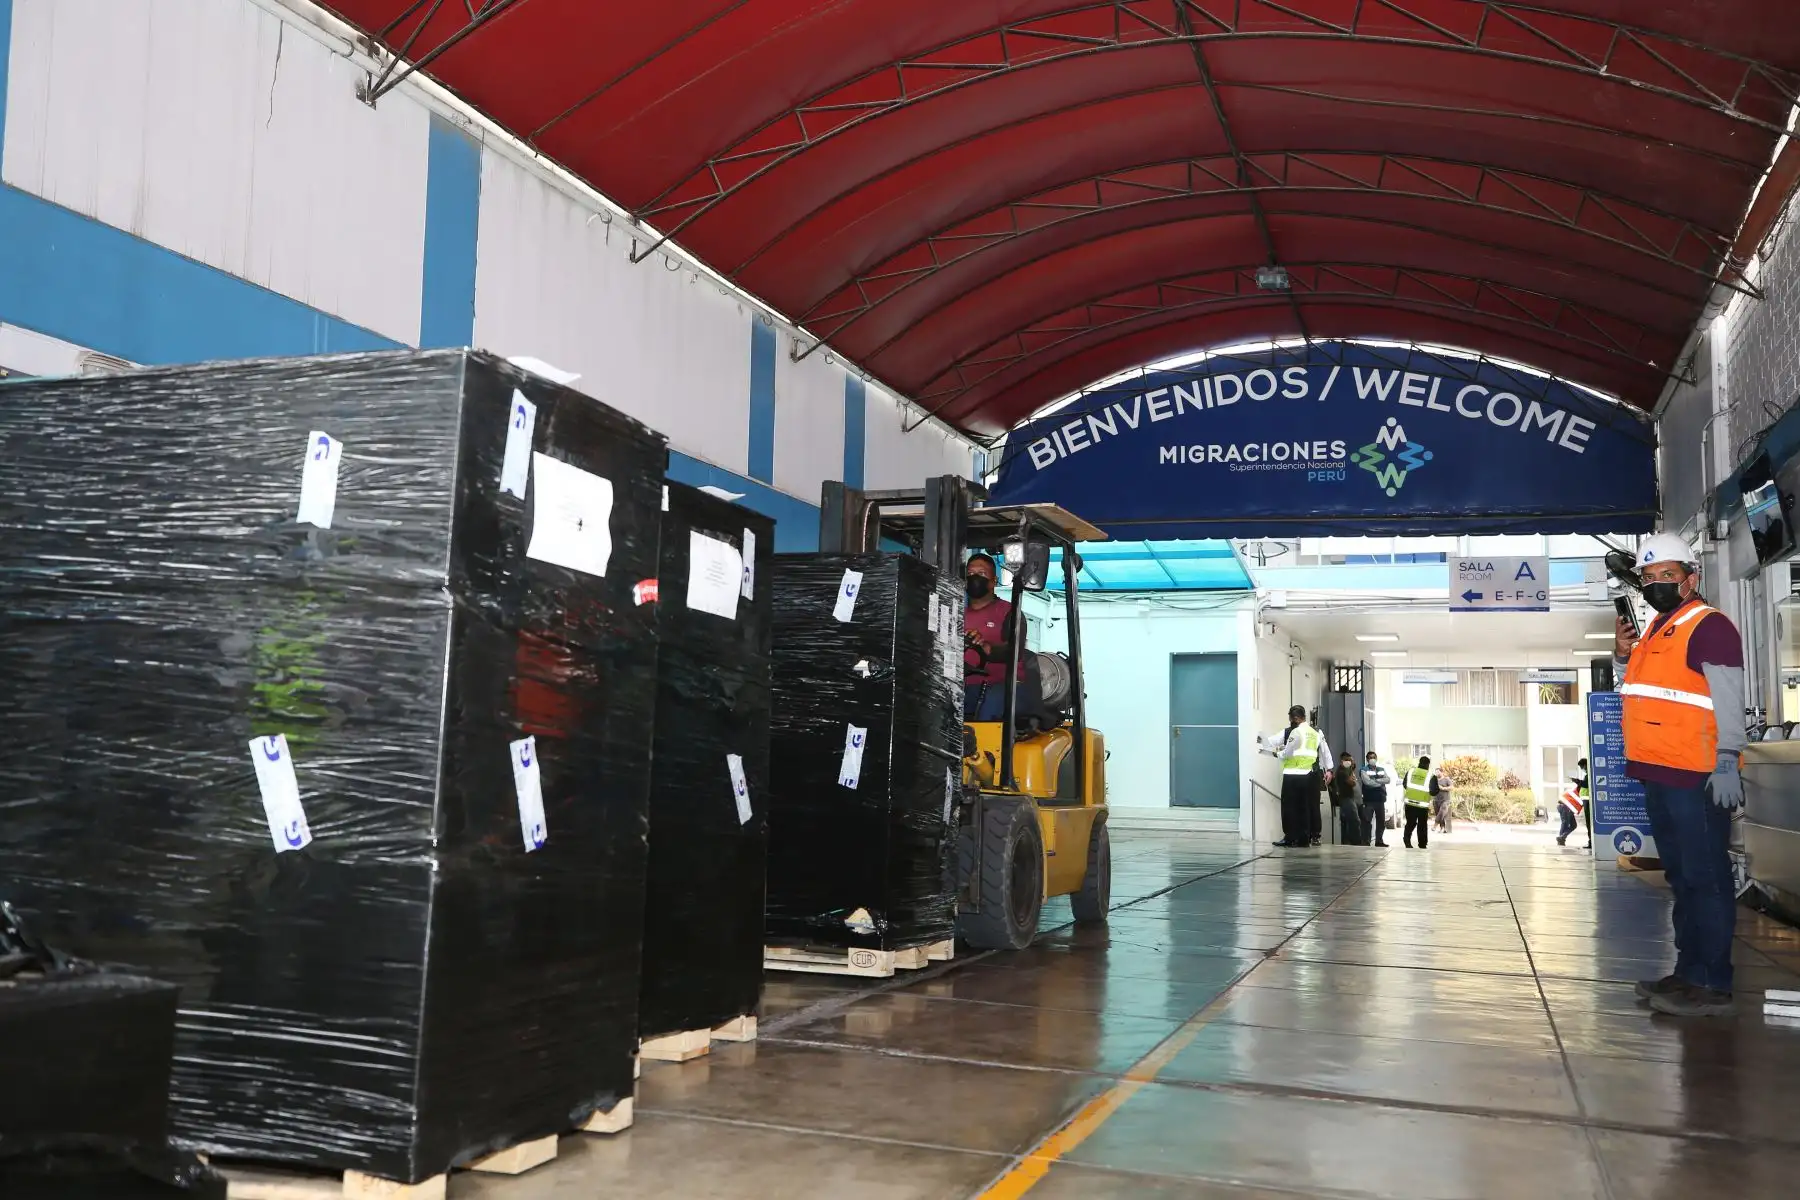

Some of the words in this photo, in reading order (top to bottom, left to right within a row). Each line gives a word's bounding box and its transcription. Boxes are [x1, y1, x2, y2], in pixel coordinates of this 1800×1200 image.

[1027, 366, 1309, 471] BIENVENIDOS
[1352, 366, 1597, 454] WELCOME
[1159, 440, 1347, 464] MIGRACIONES
[1229, 462, 1306, 473] Superintendencia
[1307, 460, 1346, 470] Nacional
[1307, 468, 1346, 482] PERÚ
[1458, 561, 1495, 572] SALA
[1514, 561, 1536, 581] A
[1459, 572, 1492, 581] ROOM
[856, 953, 872, 965] EUR
